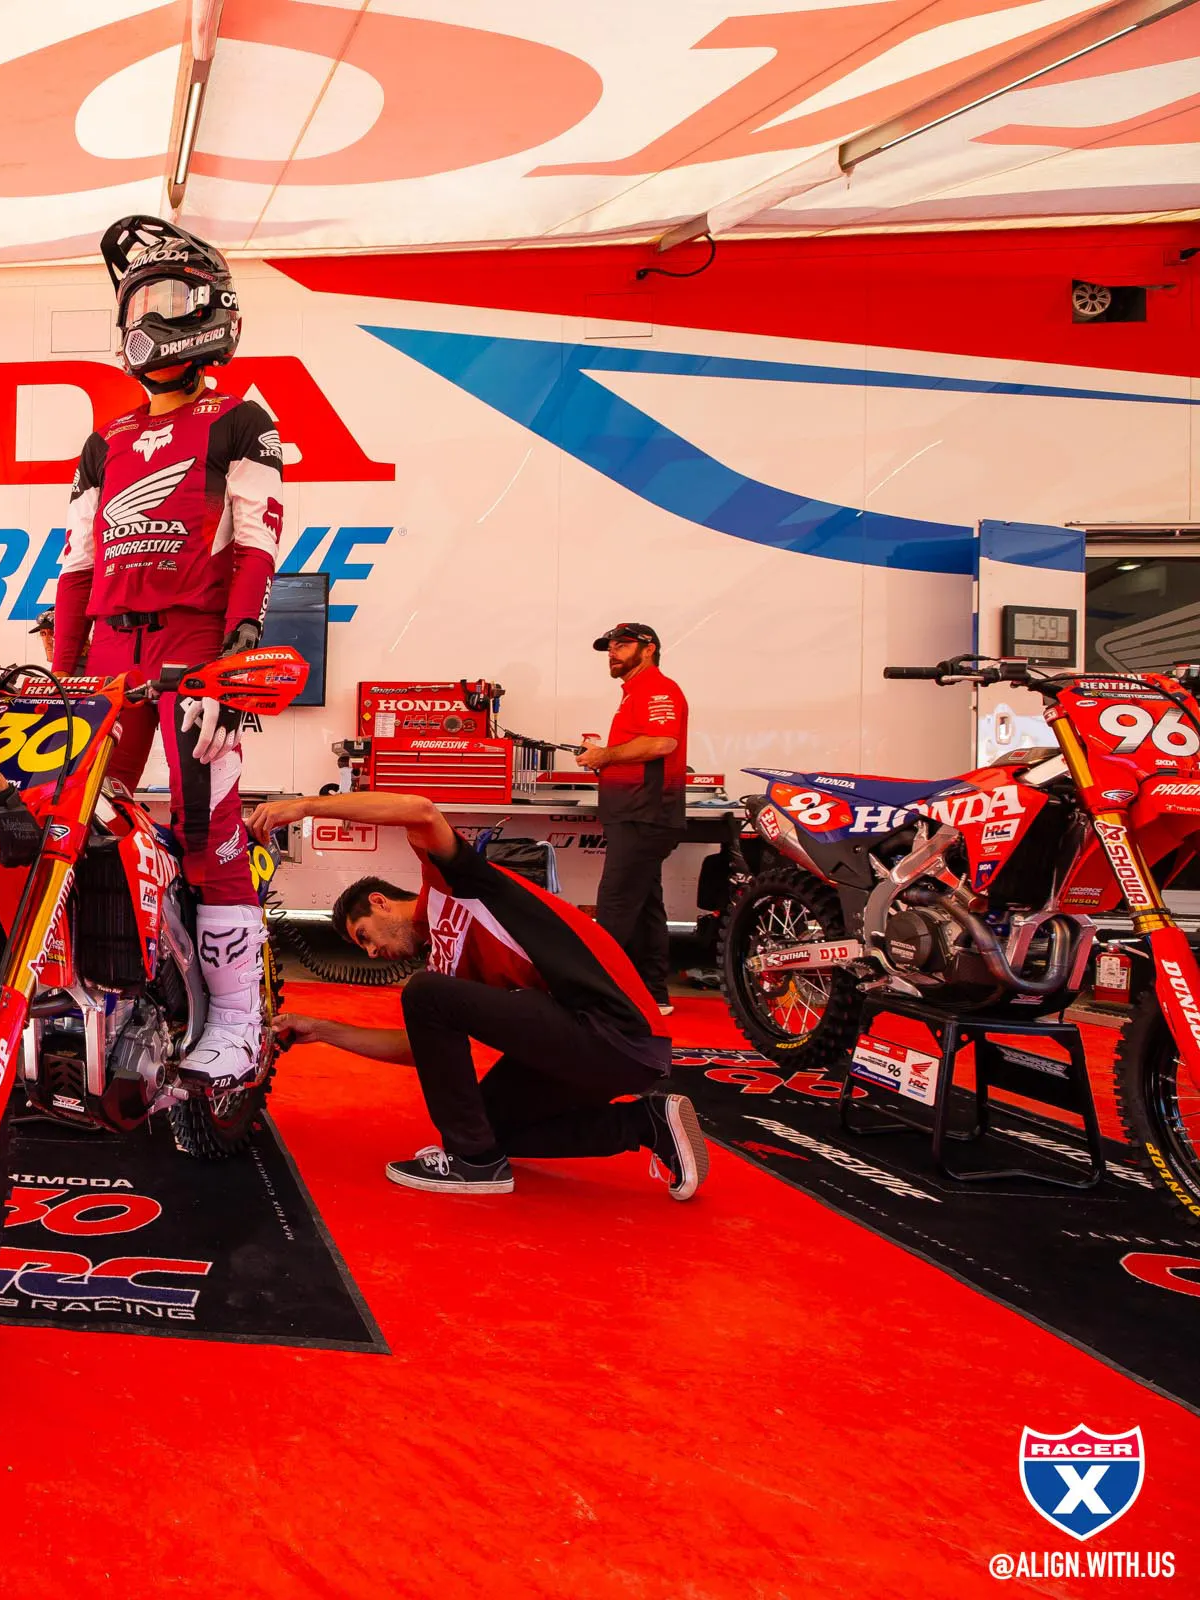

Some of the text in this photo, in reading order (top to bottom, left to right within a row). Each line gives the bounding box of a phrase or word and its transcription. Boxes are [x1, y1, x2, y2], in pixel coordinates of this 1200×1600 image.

[102, 520, 189, 544] HONDA
[103, 538, 184, 562] PROGRESSIVE
[124, 561, 154, 570] DUNLOP
[245, 652, 294, 663] HONDA
[377, 699, 471, 712] HONDA
[1099, 703, 1200, 757] 96
[410, 740, 471, 750] PROGRESSIVE
[813, 776, 857, 790] HONDA
[848, 784, 1027, 835] HONDA
[316, 825, 373, 842] GET
[1106, 842, 1150, 906] SHOWA
[887, 1063, 902, 1078] 96
[212, 1076, 232, 1088] FOX
[30, 1298, 196, 1321] RACING
